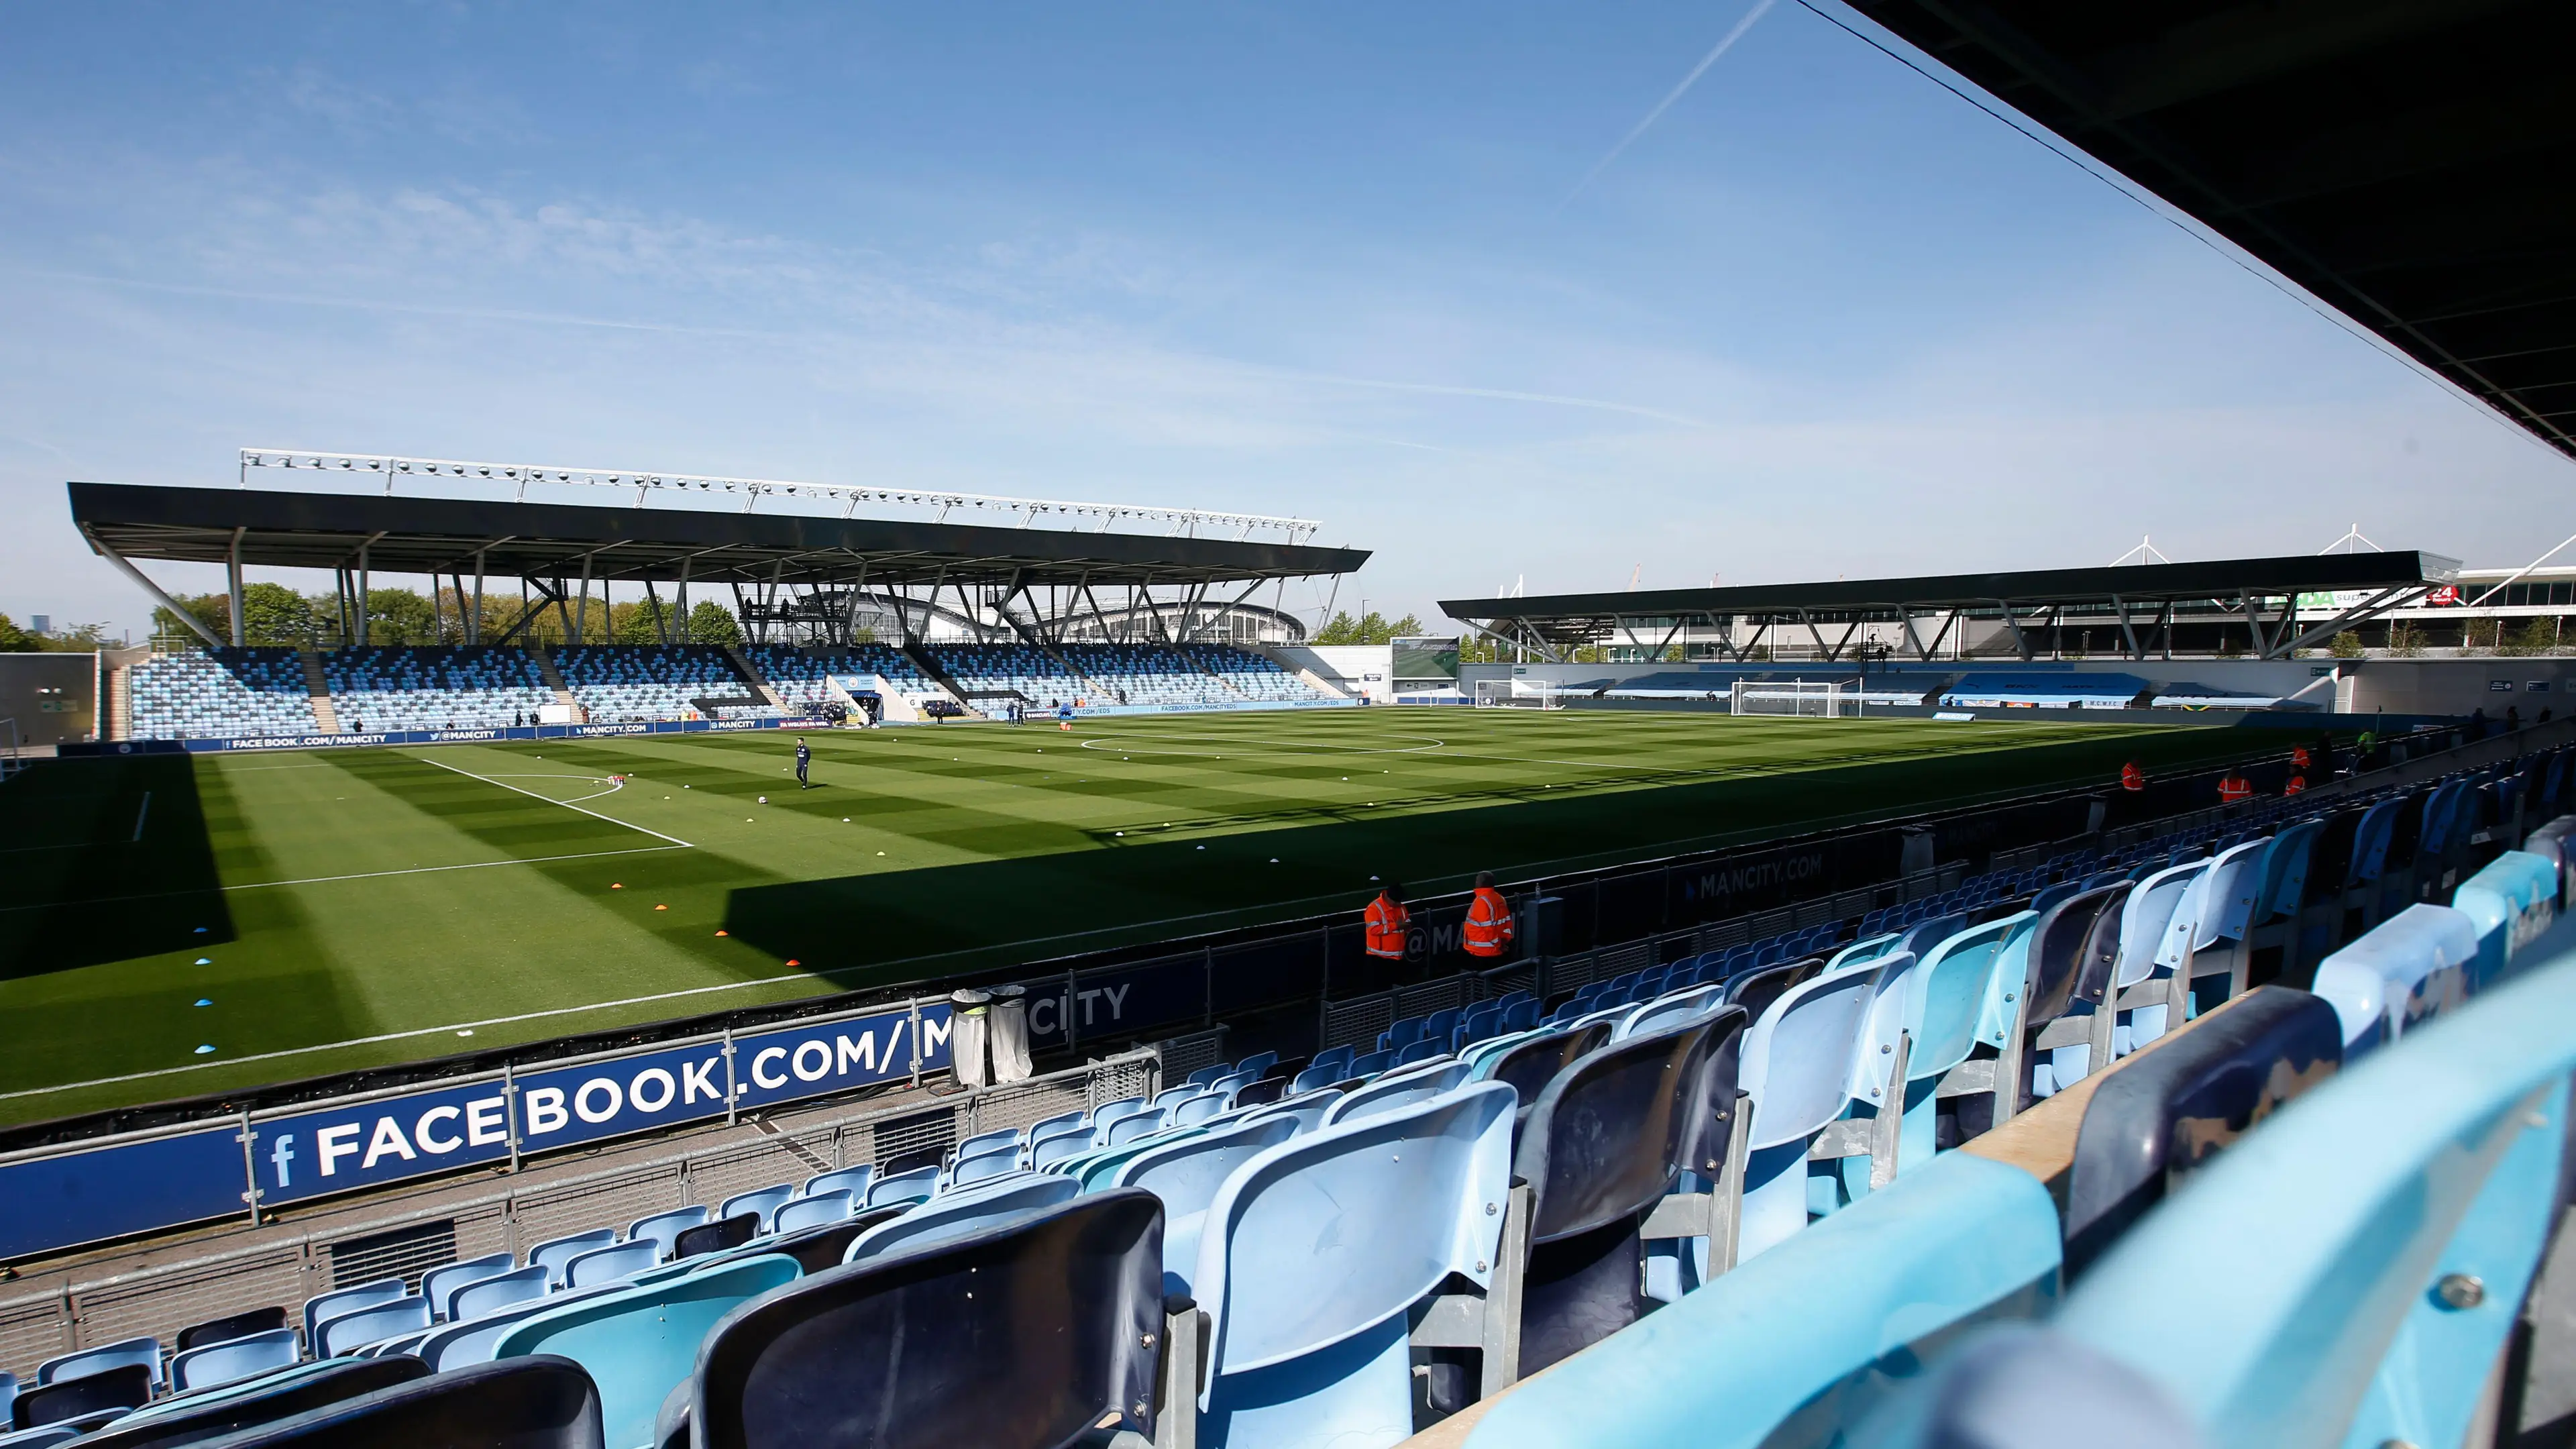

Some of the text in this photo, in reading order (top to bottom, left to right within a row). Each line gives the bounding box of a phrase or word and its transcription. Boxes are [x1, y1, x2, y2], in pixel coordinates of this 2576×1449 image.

[2432, 586, 2453, 597] 24
[1161, 704, 1236, 712] FACEBOOK.COM/MANCITYEDS
[583, 724, 647, 735] MANCITY.COM
[718, 720, 755, 729] MANCITY
[441, 731, 496, 741] @MANCITY
[232, 735, 387, 749] FACEBOOK.COM/MANCITY
[1701, 853, 1822, 899] MANCITY.COM
